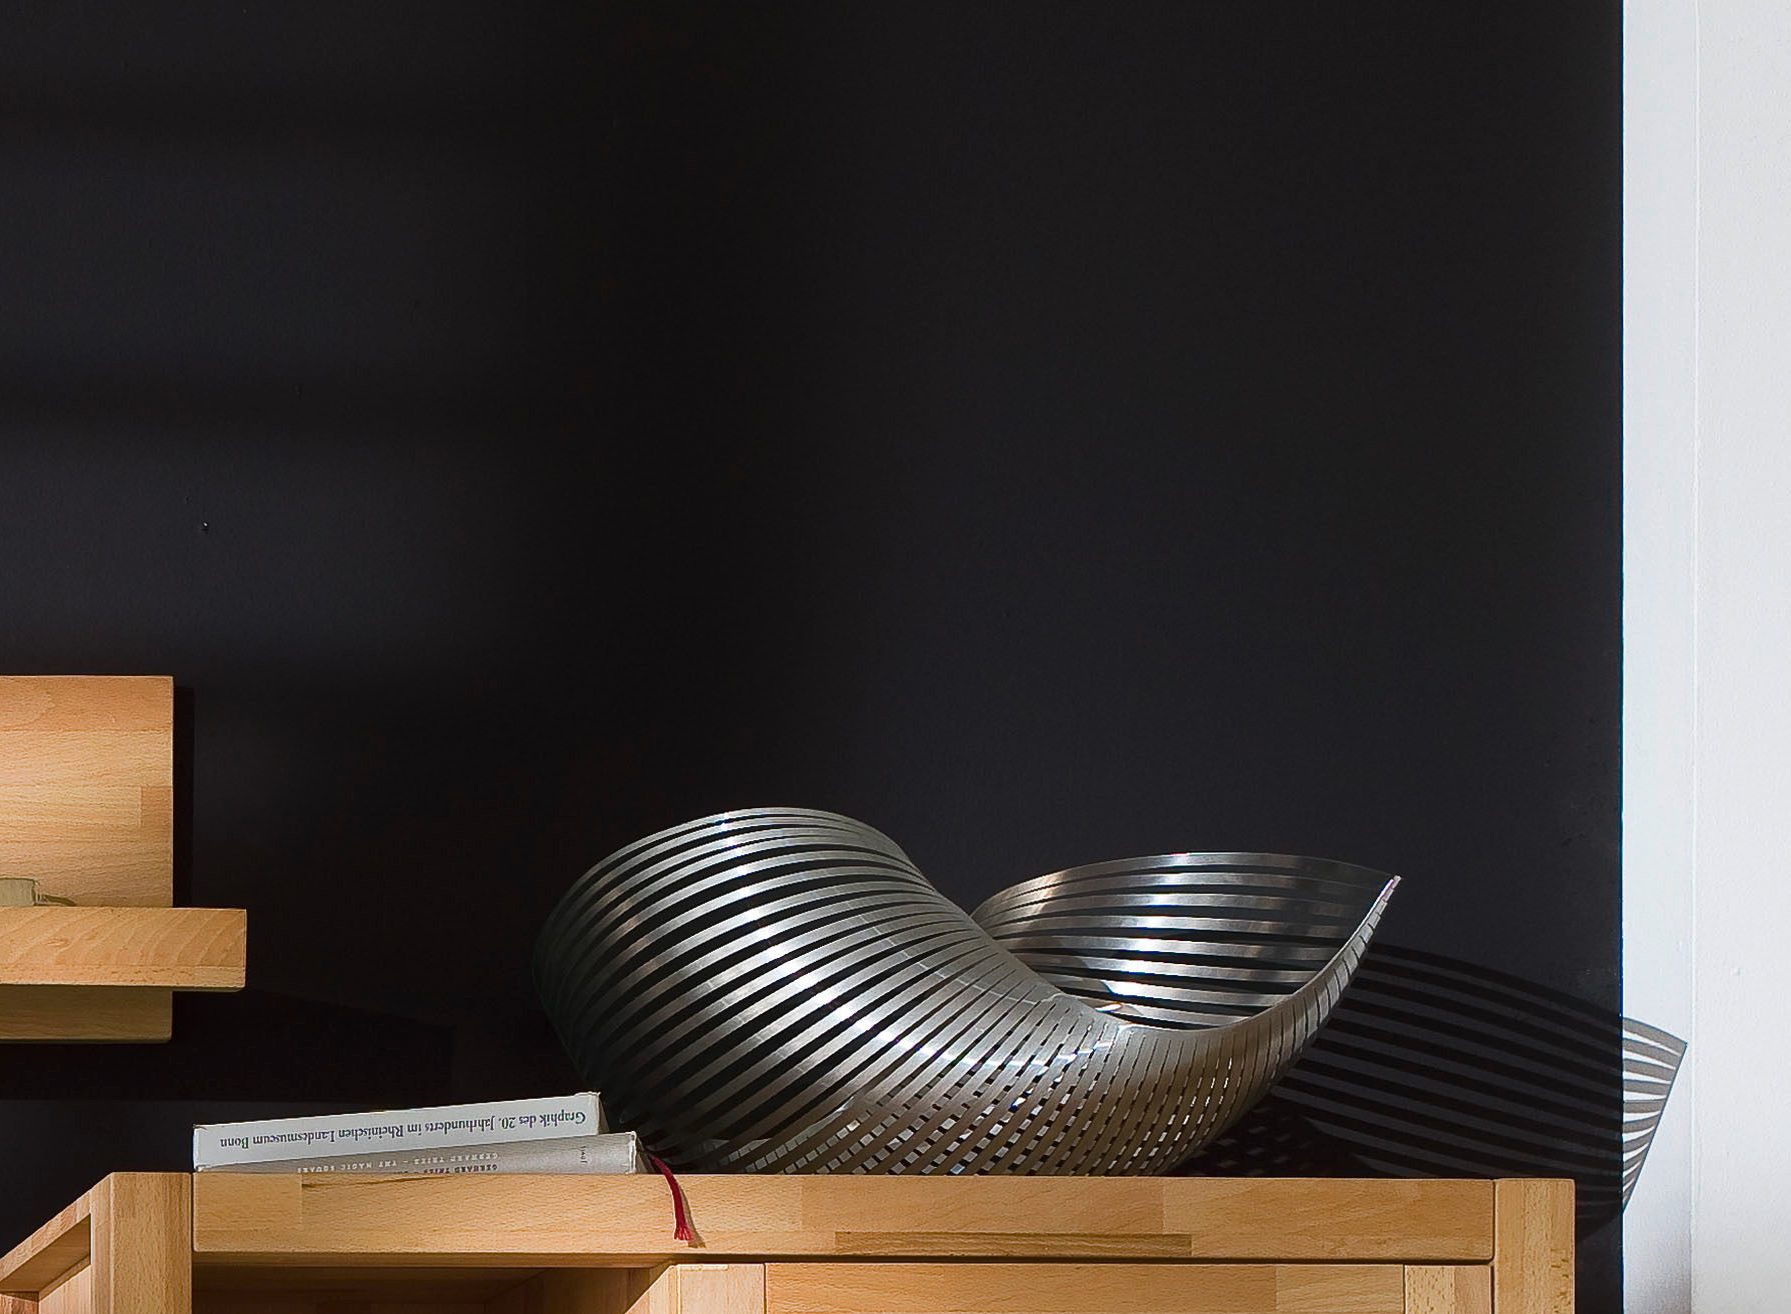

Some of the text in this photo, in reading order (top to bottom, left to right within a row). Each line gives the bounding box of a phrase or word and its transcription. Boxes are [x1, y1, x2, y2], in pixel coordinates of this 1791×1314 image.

[220, 1110, 585, 1149] Graphik des 20. Jahrhunderts im Rheinischen Landesmuseum Bonn
